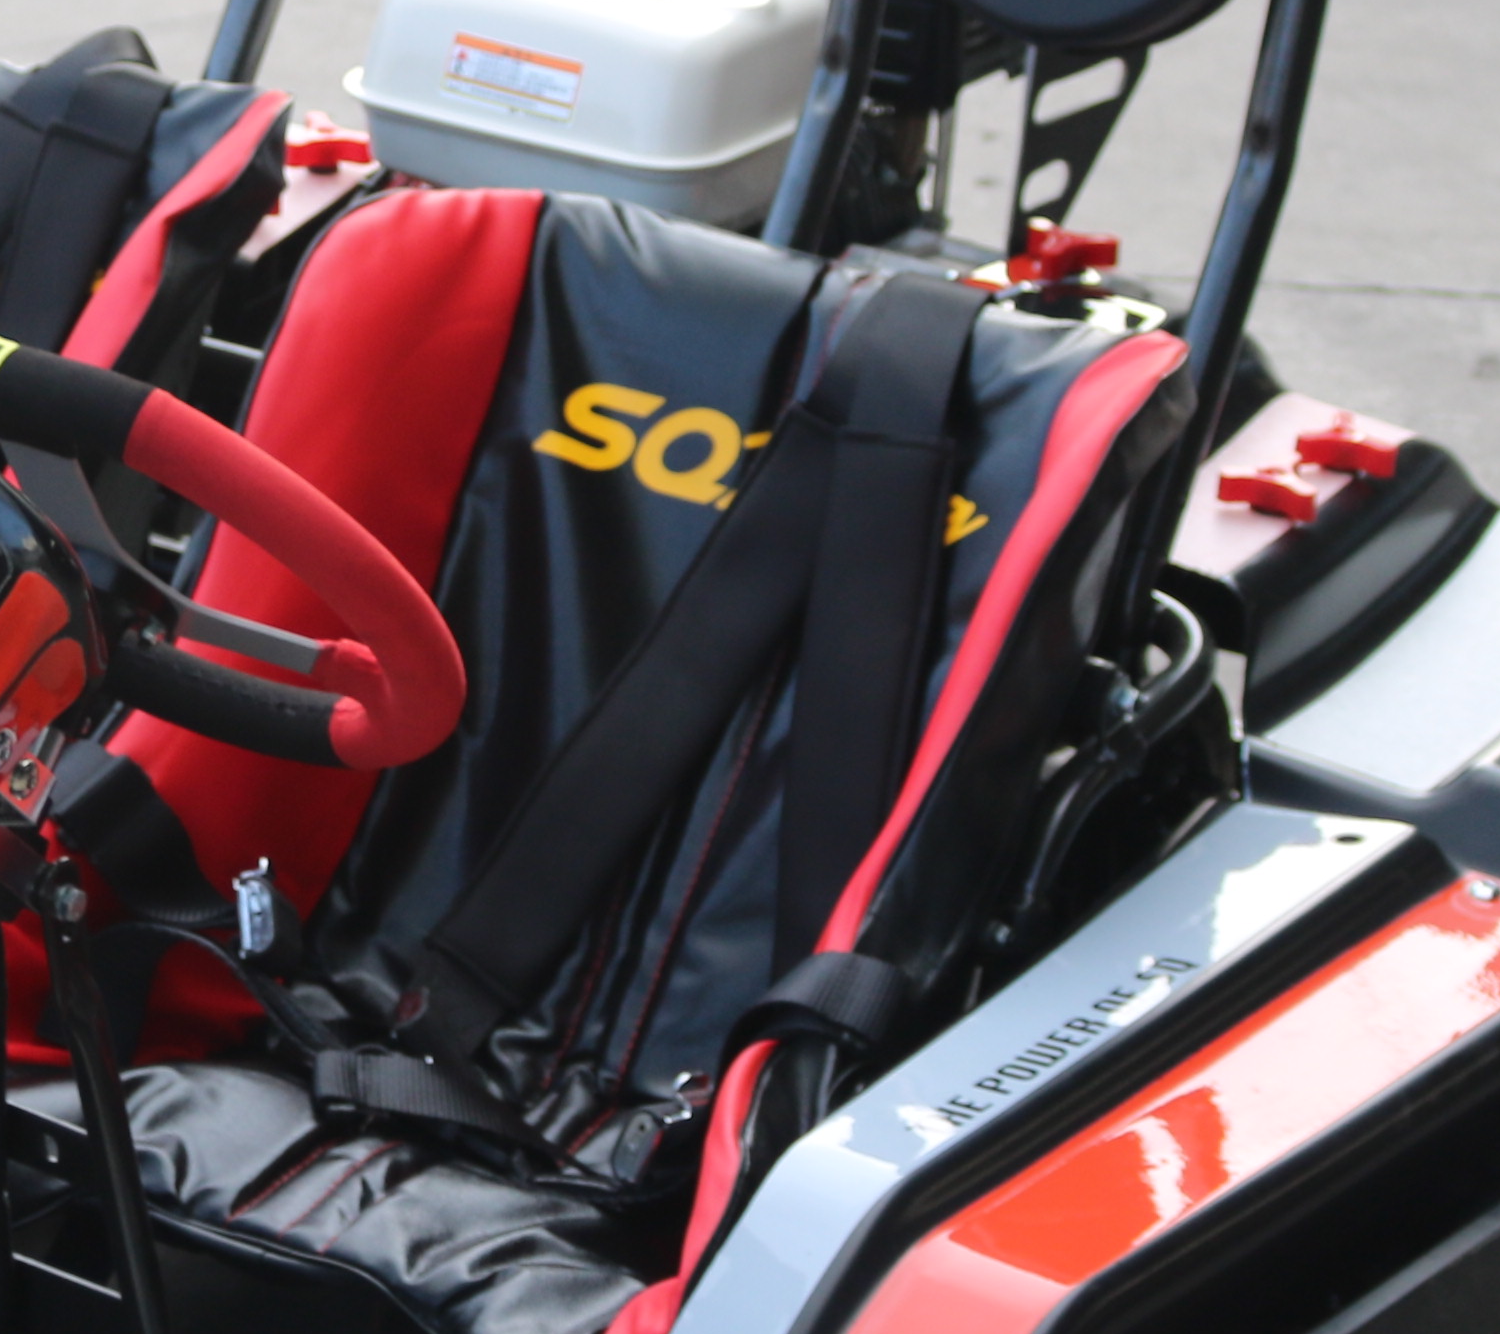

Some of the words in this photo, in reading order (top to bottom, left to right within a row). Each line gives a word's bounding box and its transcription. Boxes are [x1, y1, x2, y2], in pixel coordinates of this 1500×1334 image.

[532, 382, 742, 511] SQ
[905, 1095, 994, 1137] HE
[974, 1015, 1110, 1097] POWER
